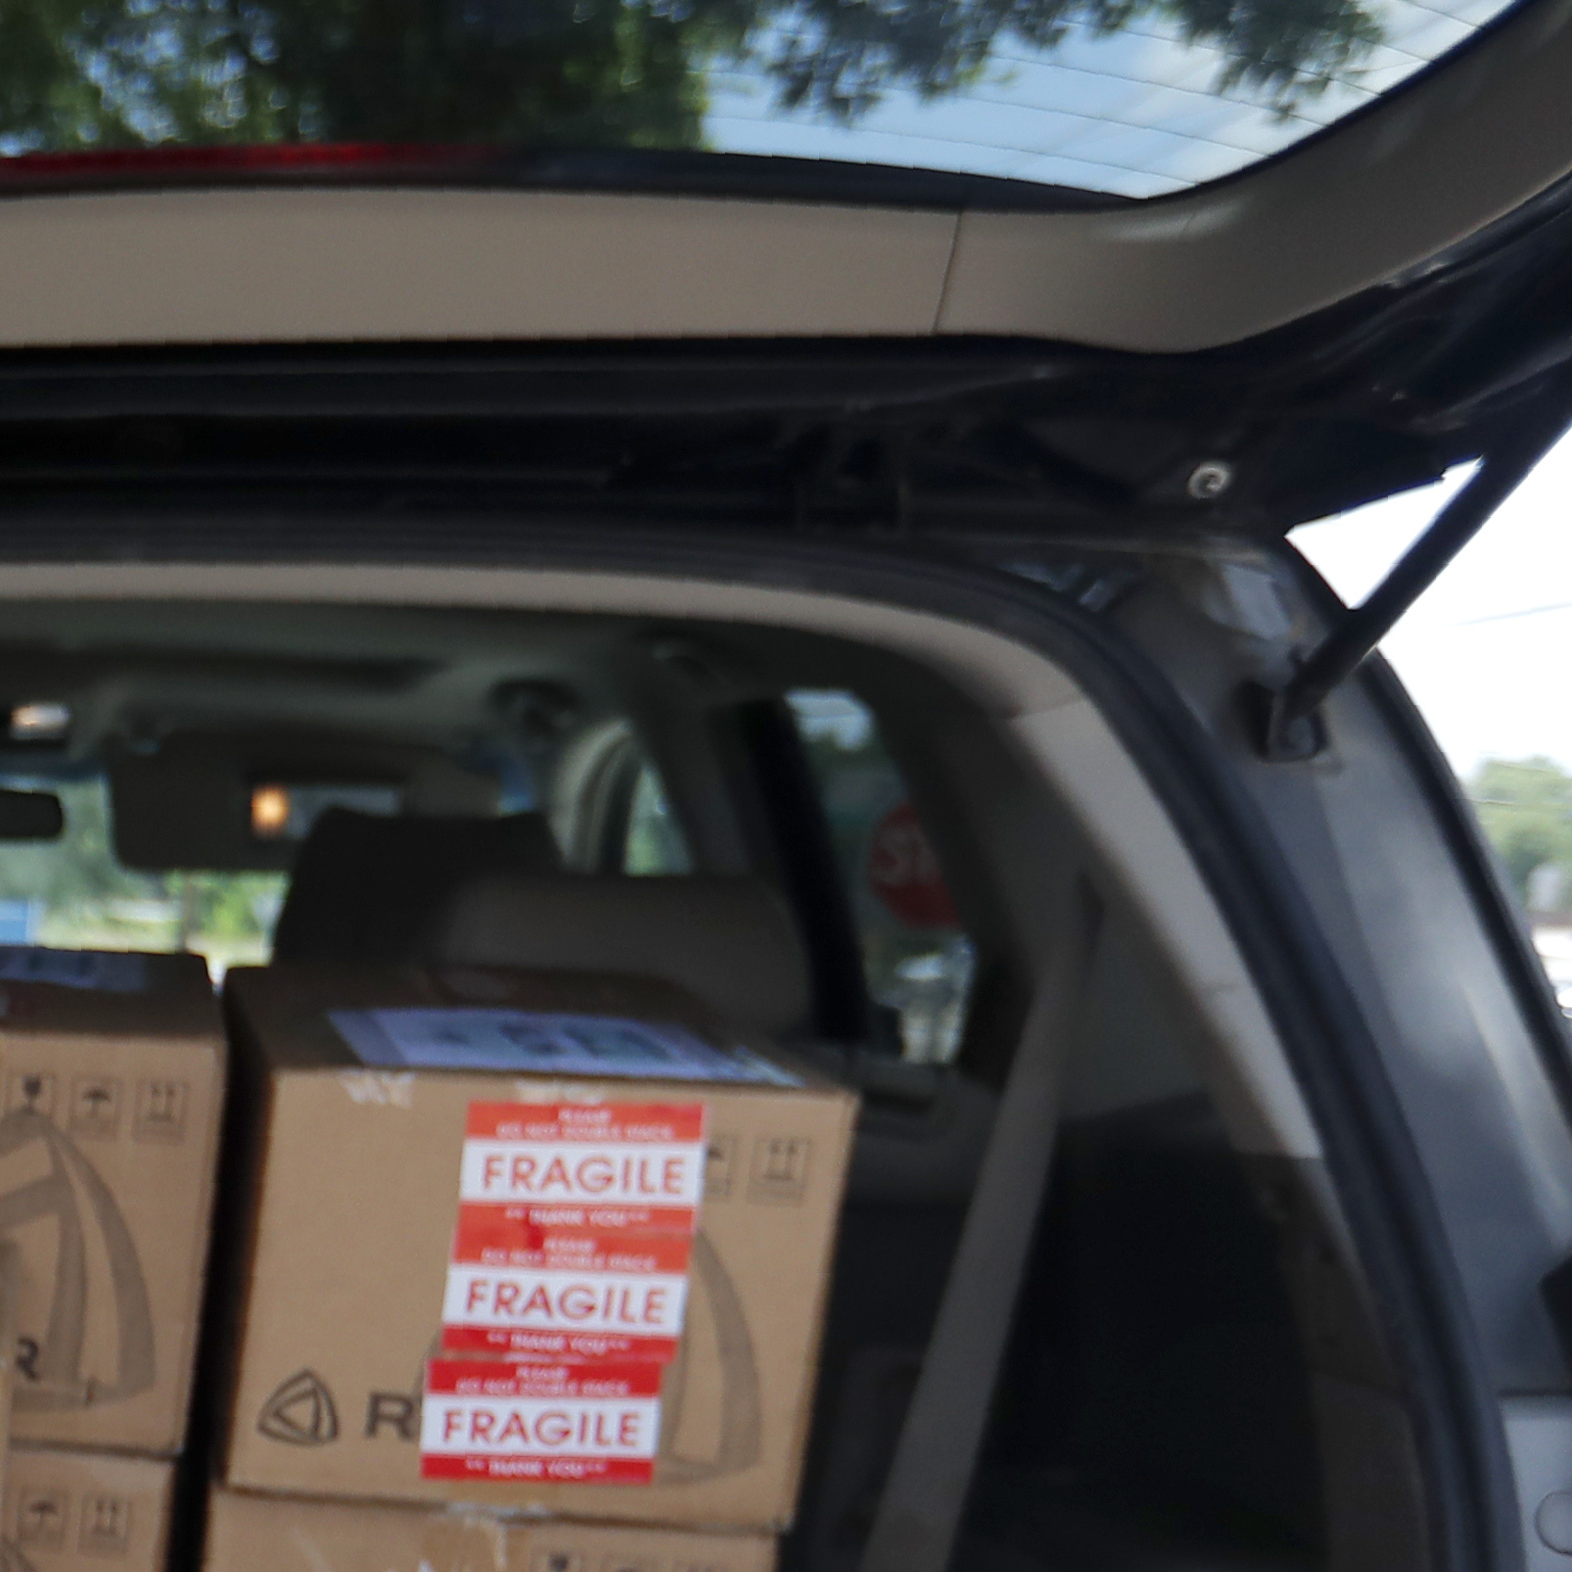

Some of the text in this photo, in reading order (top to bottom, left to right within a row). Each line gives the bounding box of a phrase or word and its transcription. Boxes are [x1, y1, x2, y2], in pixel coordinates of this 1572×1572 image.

[484, 1155, 684, 1193] FRAGILE
[466, 1280, 668, 1324] FRAGILE
[443, 1410, 641, 1446] FRAGILE
